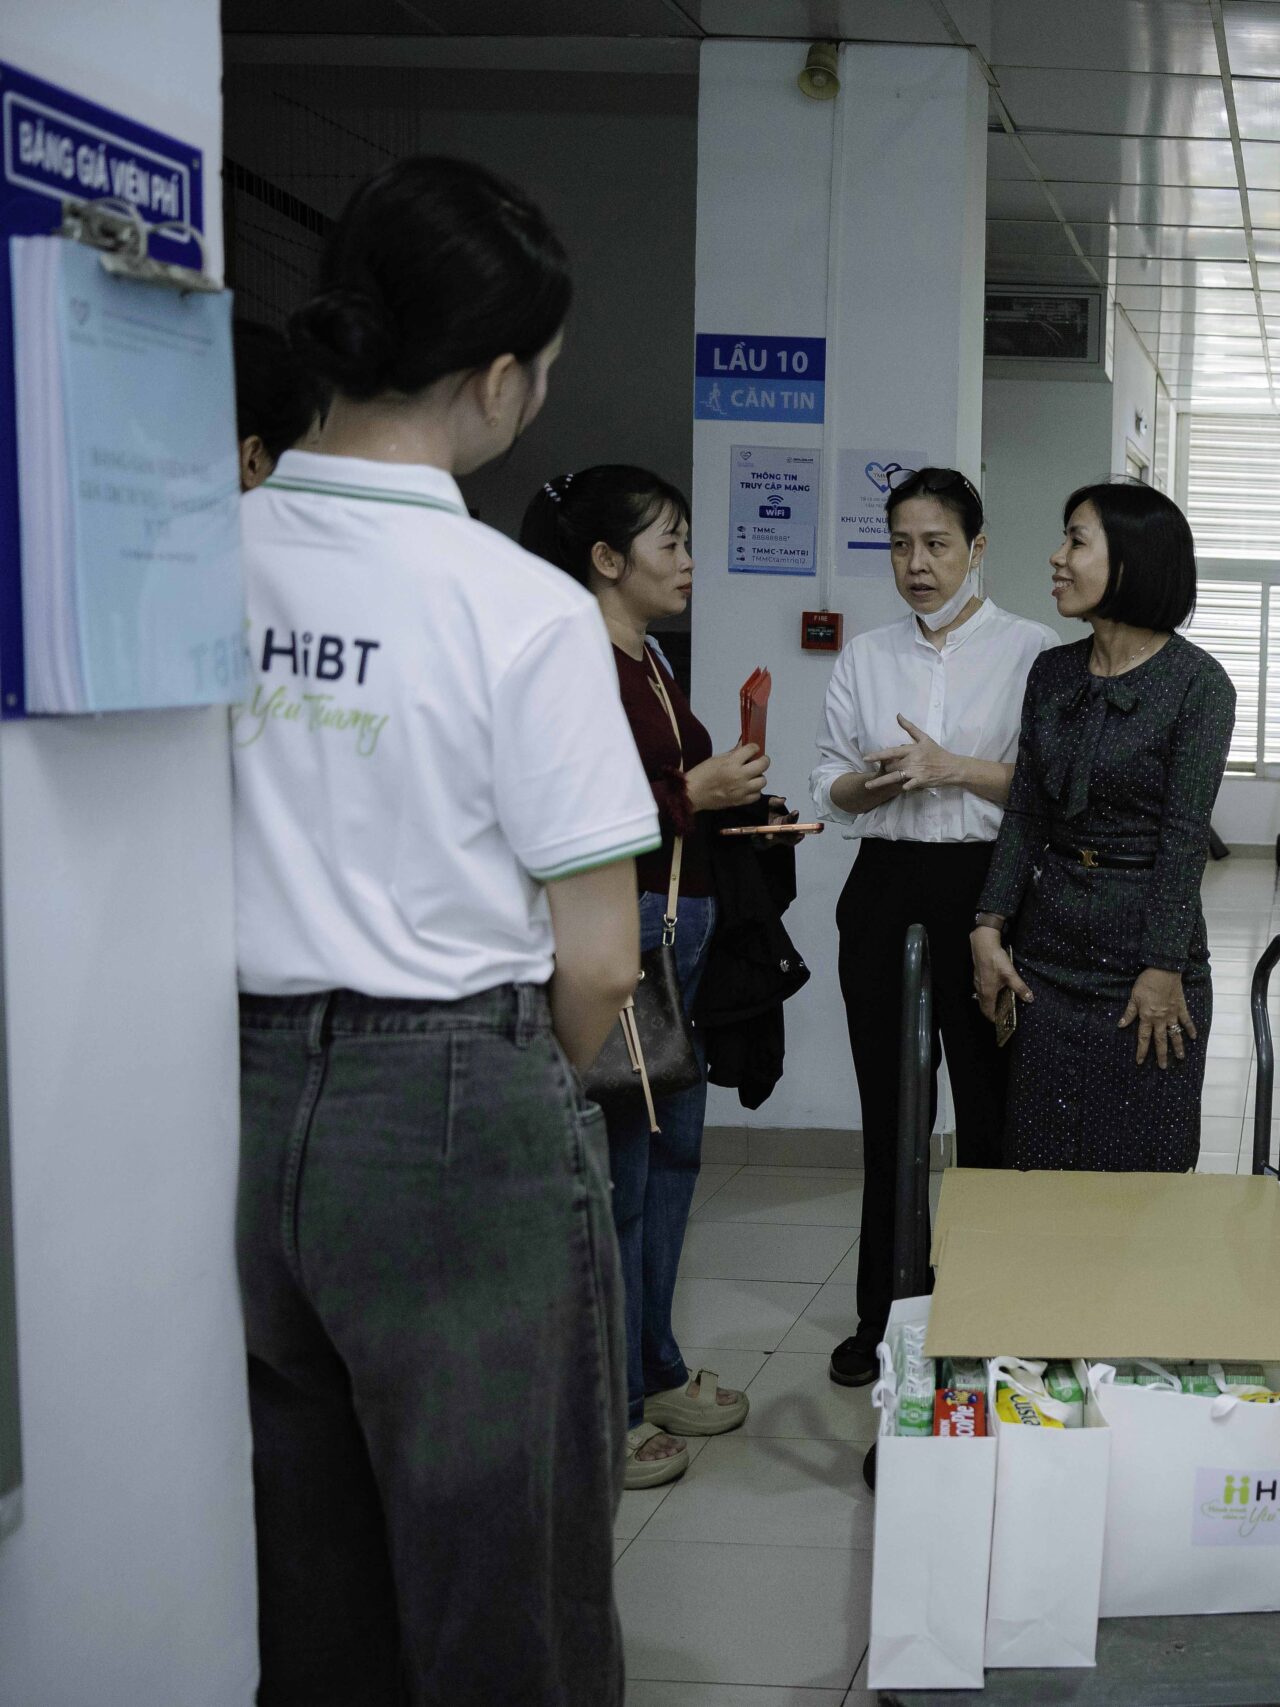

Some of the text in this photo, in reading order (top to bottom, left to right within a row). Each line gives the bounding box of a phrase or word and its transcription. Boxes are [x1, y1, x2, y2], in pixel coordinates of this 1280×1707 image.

[713, 341, 809, 374] LẦU 10
[781, 391, 815, 410] TIN
[751, 471, 798, 481] THÔNG TIN
[740, 482, 811, 493] TRUY CẬP MẠNG
[765, 508, 785, 517] WiFi
[841, 515, 857, 523] KHU
[752, 526, 776, 534] TMMC
[752, 547, 809, 556] TMMC-TAMTRI
[261, 628, 381, 686] HiBT
